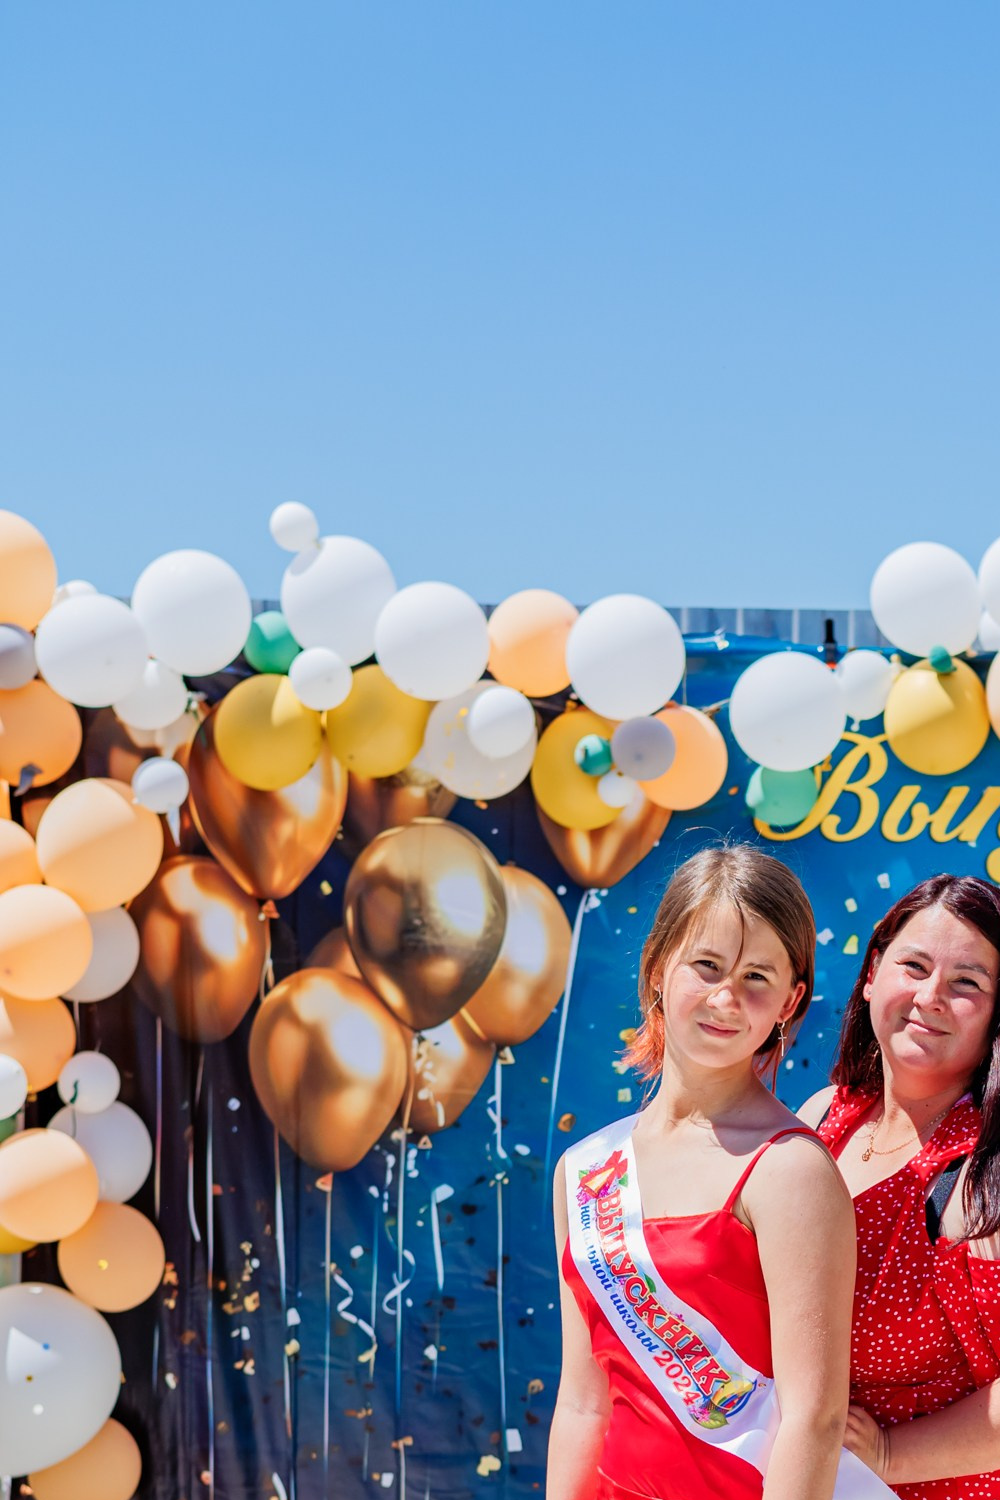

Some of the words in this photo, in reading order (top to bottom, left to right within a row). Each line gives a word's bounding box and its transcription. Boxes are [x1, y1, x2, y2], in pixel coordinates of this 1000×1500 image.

[595, 1188, 731, 1396] ВЫПУСКНИК
[608, 1291, 661, 1354] школы
[653, 1349, 702, 1407] 2024
